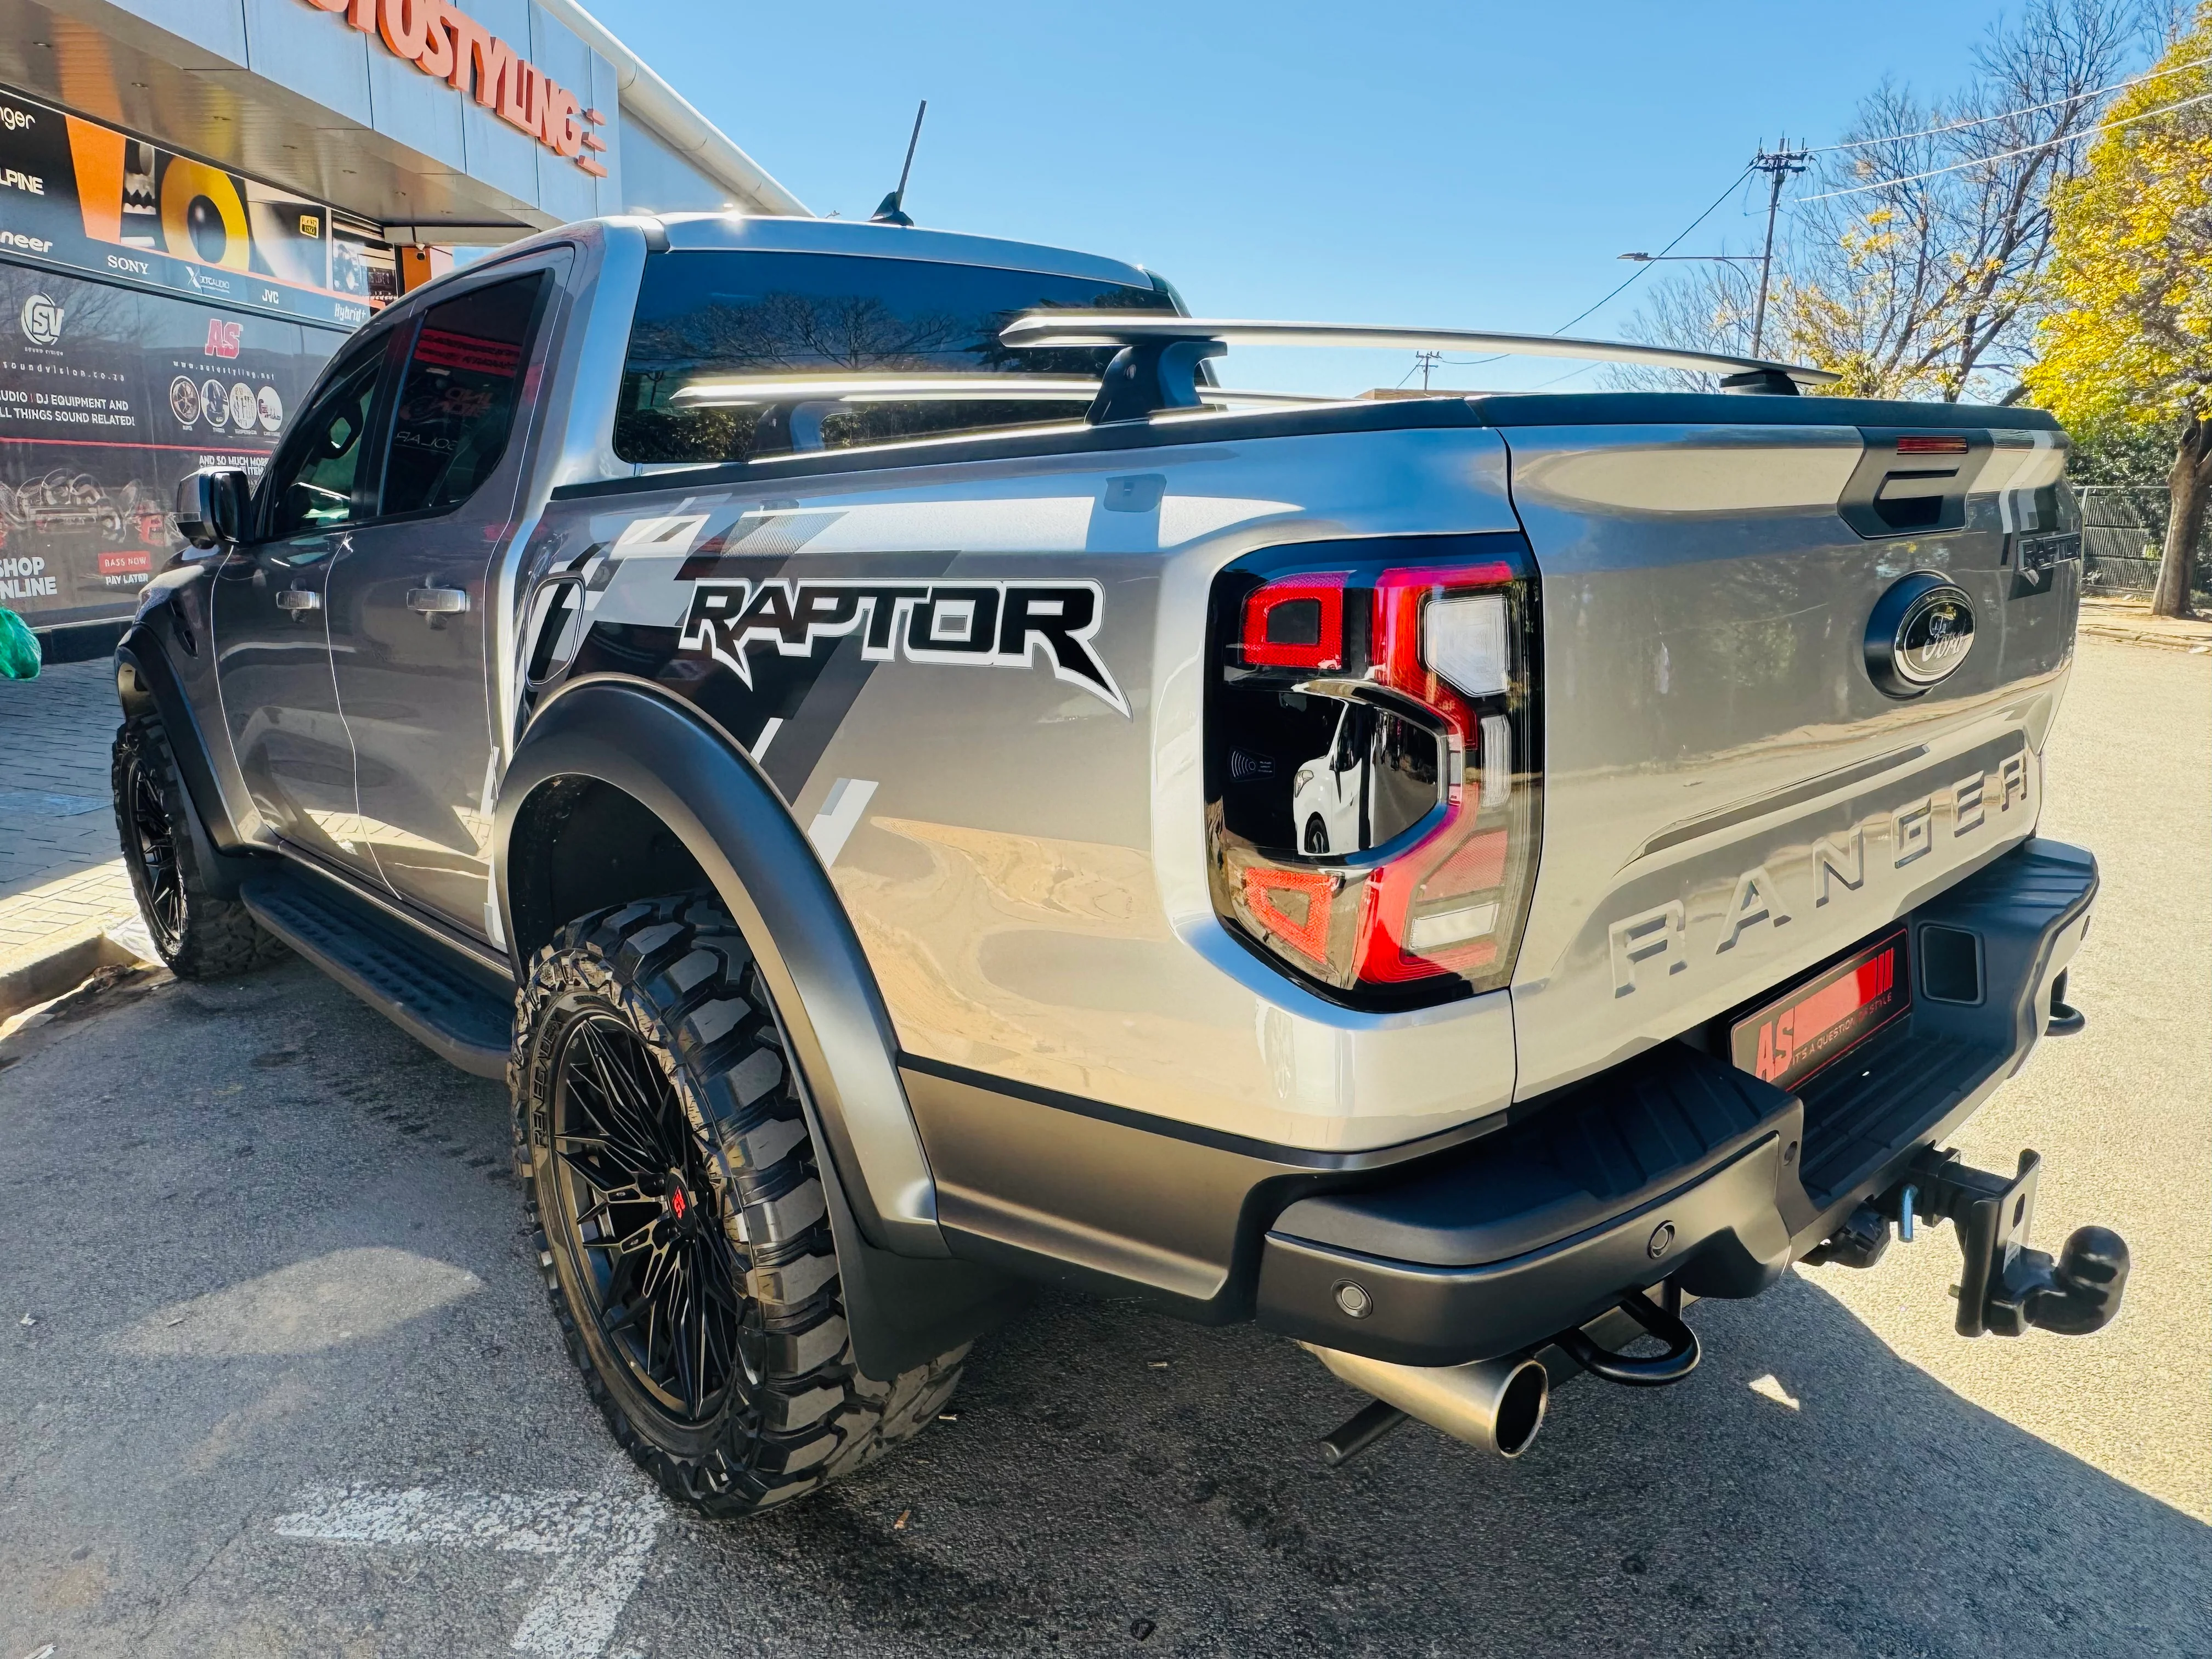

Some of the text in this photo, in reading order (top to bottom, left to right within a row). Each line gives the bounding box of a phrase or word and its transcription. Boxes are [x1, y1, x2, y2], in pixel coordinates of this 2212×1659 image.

[302, 0, 583, 156] OSTYLING
[108, 255, 149, 274] SONY
[262, 289, 279, 304] JVC
[205, 318, 244, 359] AS
[13, 408, 53, 421] THINGS
[55, 410, 89, 423] SOUND
[92, 413, 135, 426] RELATED!
[36, 393, 48, 405] DJ
[51, 394, 106, 410] EQUIPMENT
[109, 399, 128, 411] AND
[199, 455, 215, 467] AND
[216, 455, 227, 465] SO
[678, 578, 1133, 723] RAPTOR
[1922, 612, 1970, 662] Ford
[1609, 749, 2027, 1000] RANGER
[1756, 1006, 1795, 1083] AS
